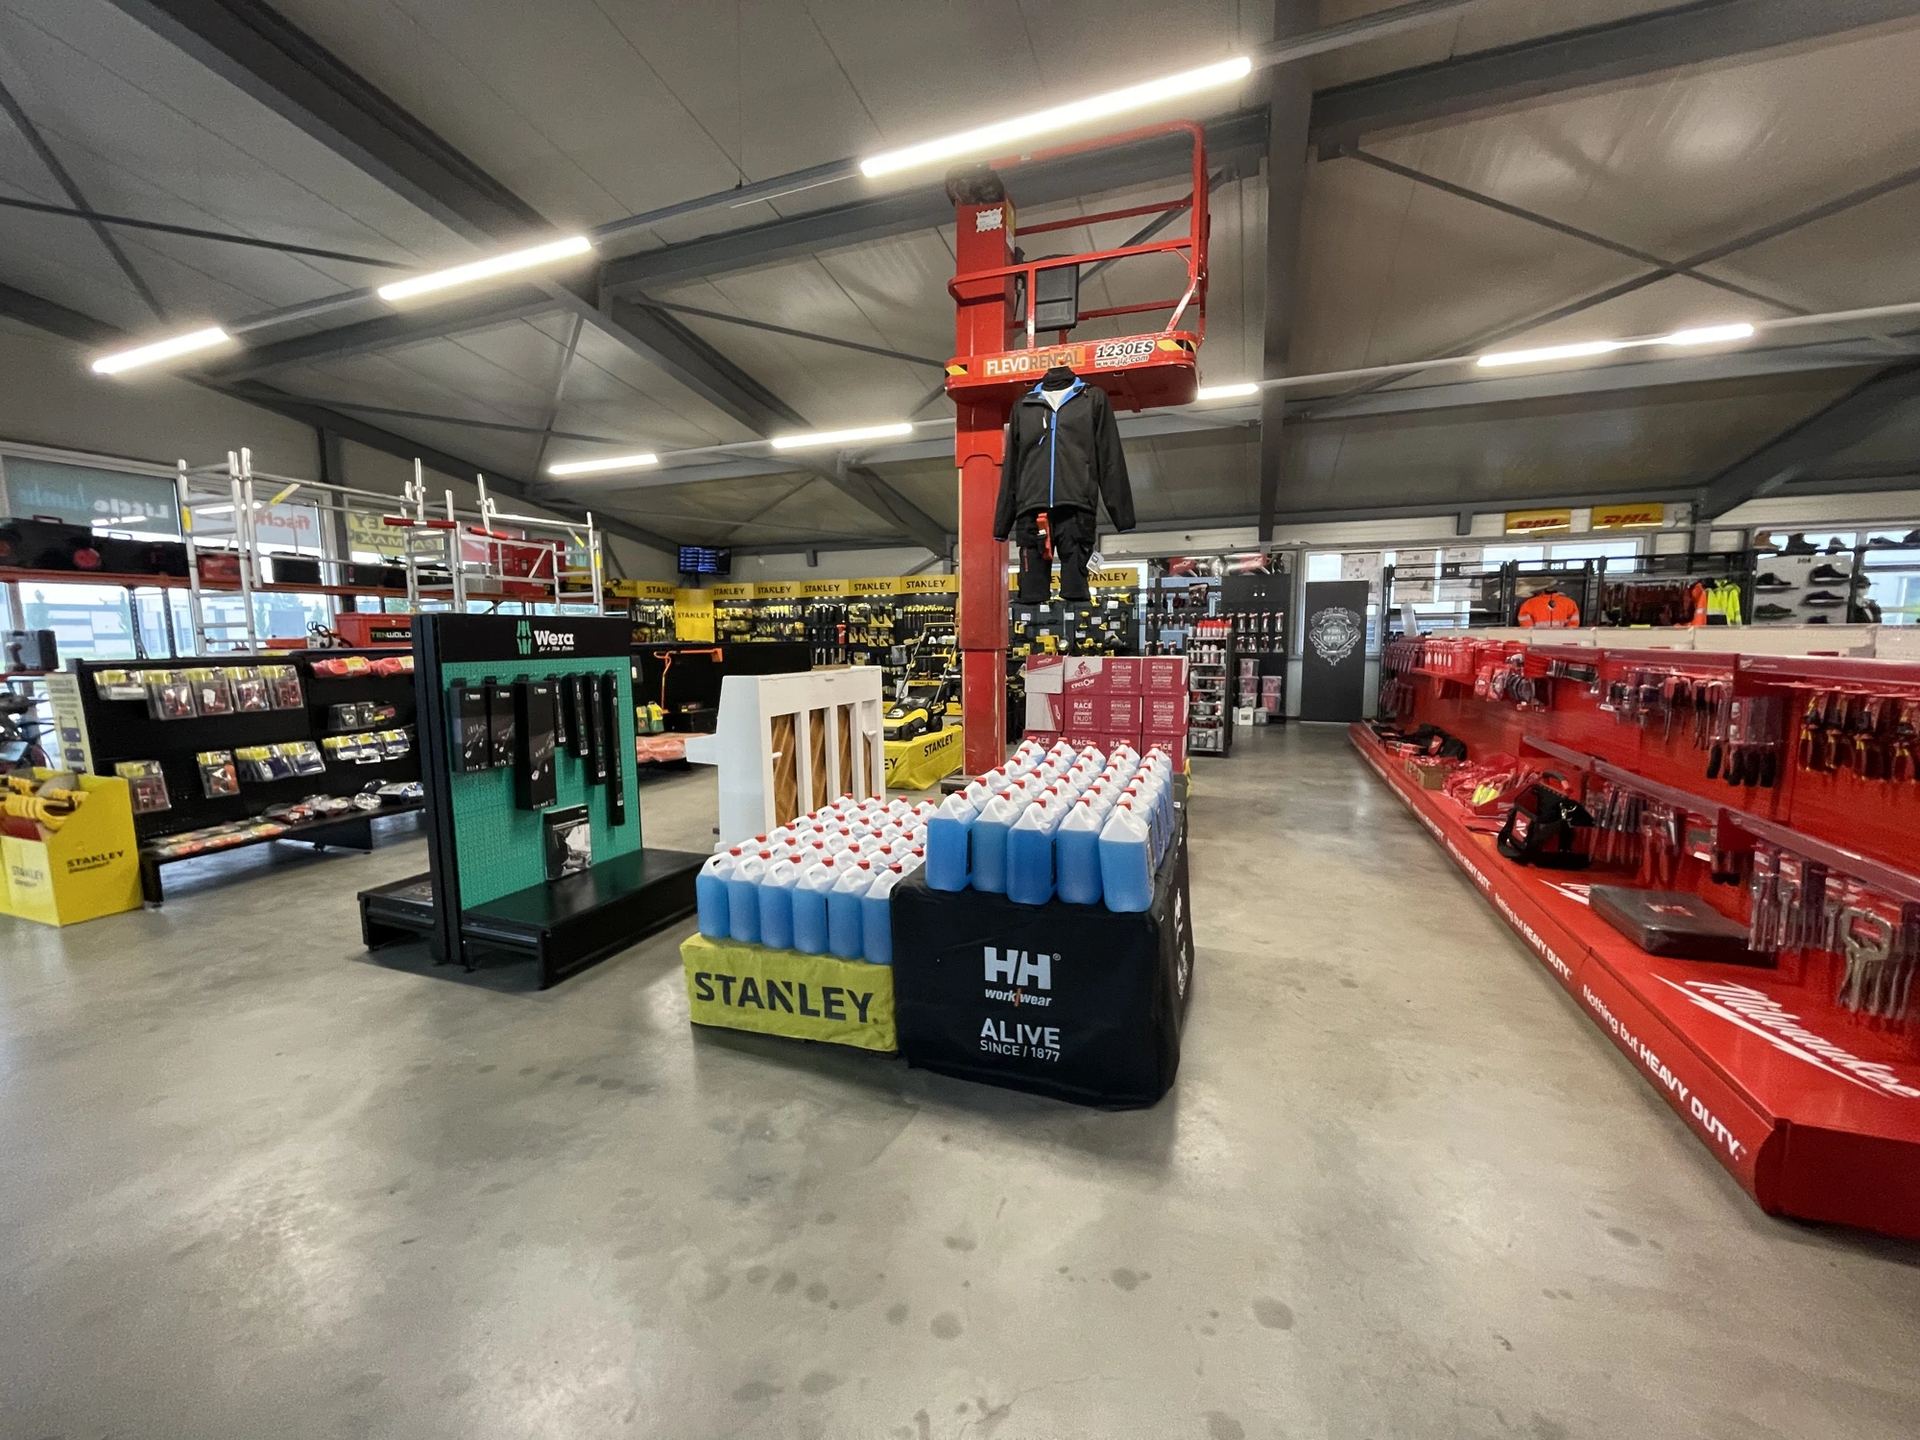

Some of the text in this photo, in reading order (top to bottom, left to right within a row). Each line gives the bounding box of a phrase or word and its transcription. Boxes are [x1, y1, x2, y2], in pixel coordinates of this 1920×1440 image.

[1097, 341, 1154, 358] 1230ES
[1517, 519, 1558, 528] DHL
[1604, 513, 1652, 523] DHL
[906, 579, 946, 589] STANLEY
[1087, 572, 1128, 583] TANLEY
[713, 587, 745, 596] STANLEY
[758, 585, 792, 594] STANLEY
[804, 584, 840, 593] STANLEY
[854, 582, 892, 591] STANLEY
[371, 631, 412, 641] TENWOLD
[533, 630, 575, 646] Wera
[924, 733, 954, 757] STANLEY
[1072, 738, 1089, 746] RAC
[67, 850, 124, 867] STANLEY
[1523, 923, 1547, 954] HEAVY
[984, 946, 1052, 990] HH
[695, 972, 874, 1024] STANLEY
[980, 1017, 1060, 1050] ALIVE
[1583, 984, 1619, 1034] Nothing
[1620, 1023, 1638, 1052] but
[1640, 1043, 1689, 1101] HEAVY
[980, 1040, 1020, 1056] SINCE
[1031, 1046, 1060, 1062] 1877
